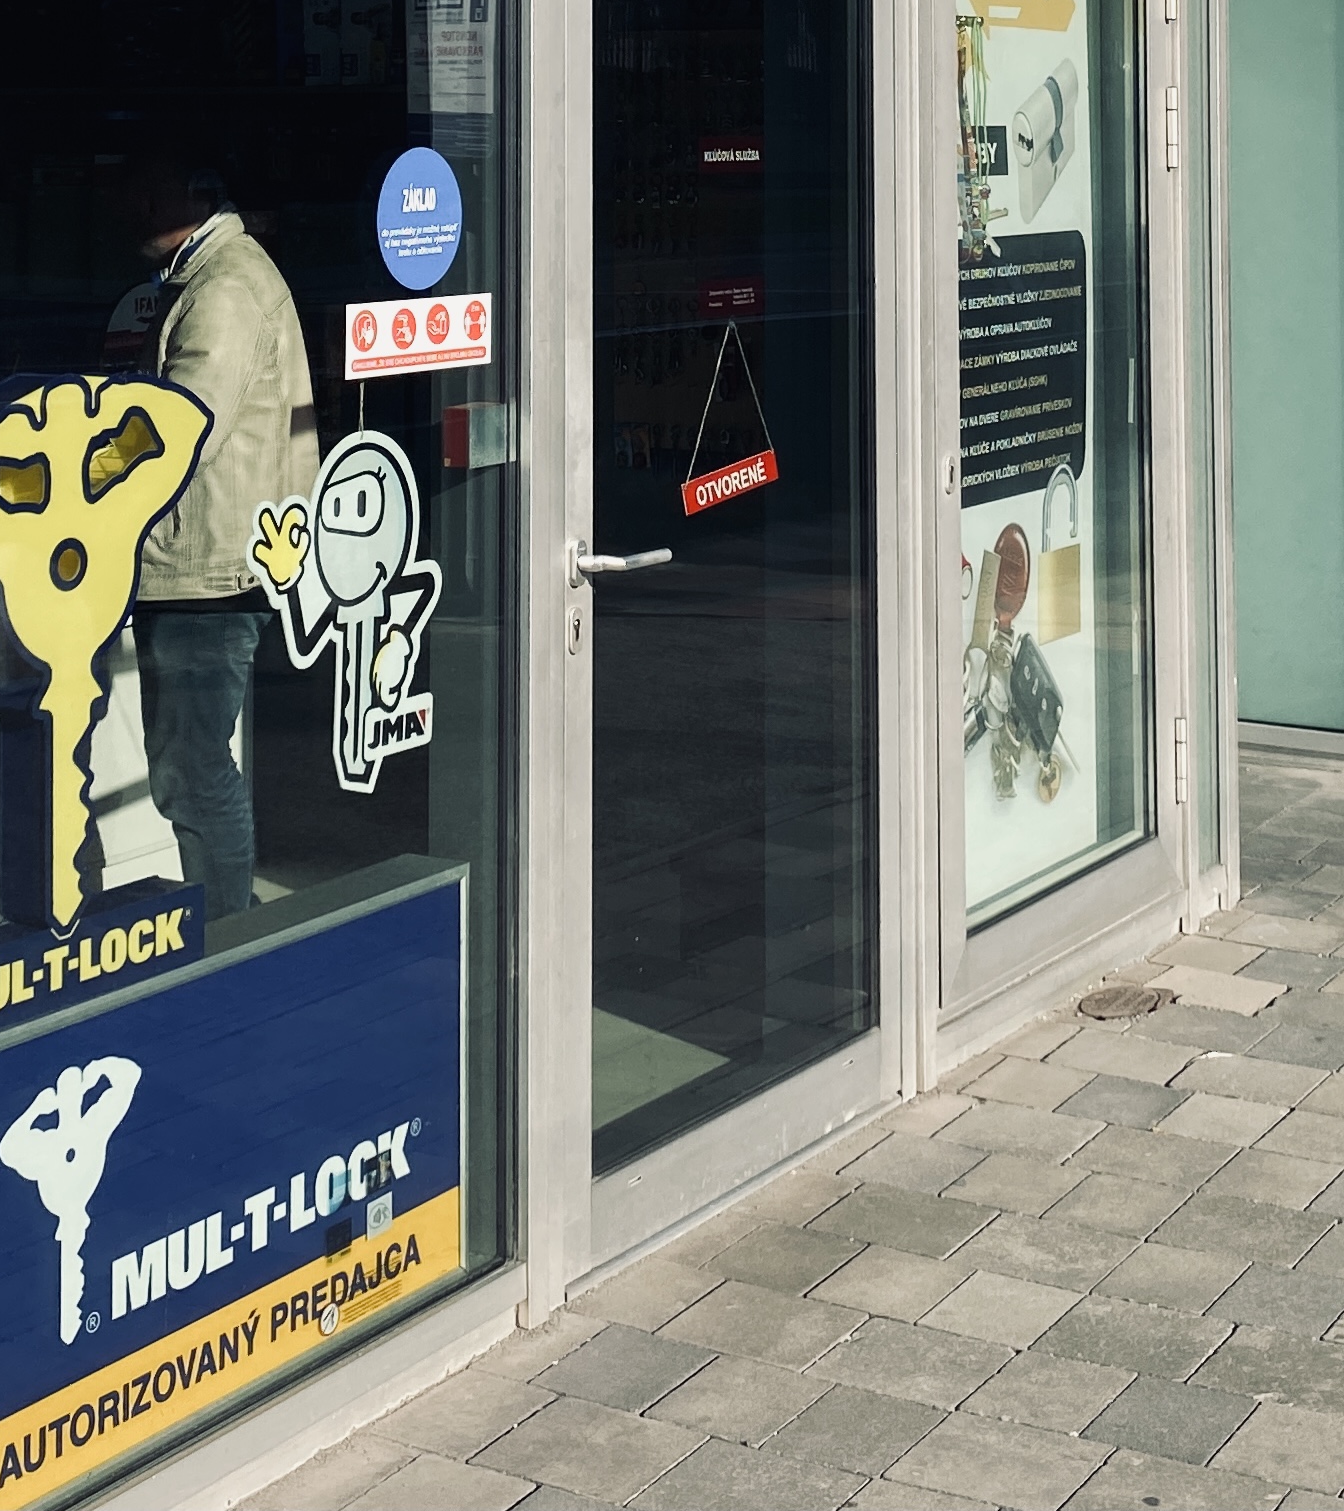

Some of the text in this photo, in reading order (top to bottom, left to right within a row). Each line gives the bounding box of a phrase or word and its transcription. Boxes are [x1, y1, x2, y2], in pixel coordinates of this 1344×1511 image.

[735, 148, 760, 161] SLUŽBA
[402, 183, 436, 213] ZÁKLAD
[695, 457, 768, 506] OTVORENÉ
[368, 711, 425, 750] JMA
[269, 1233, 422, 1344] PREDAJCA
